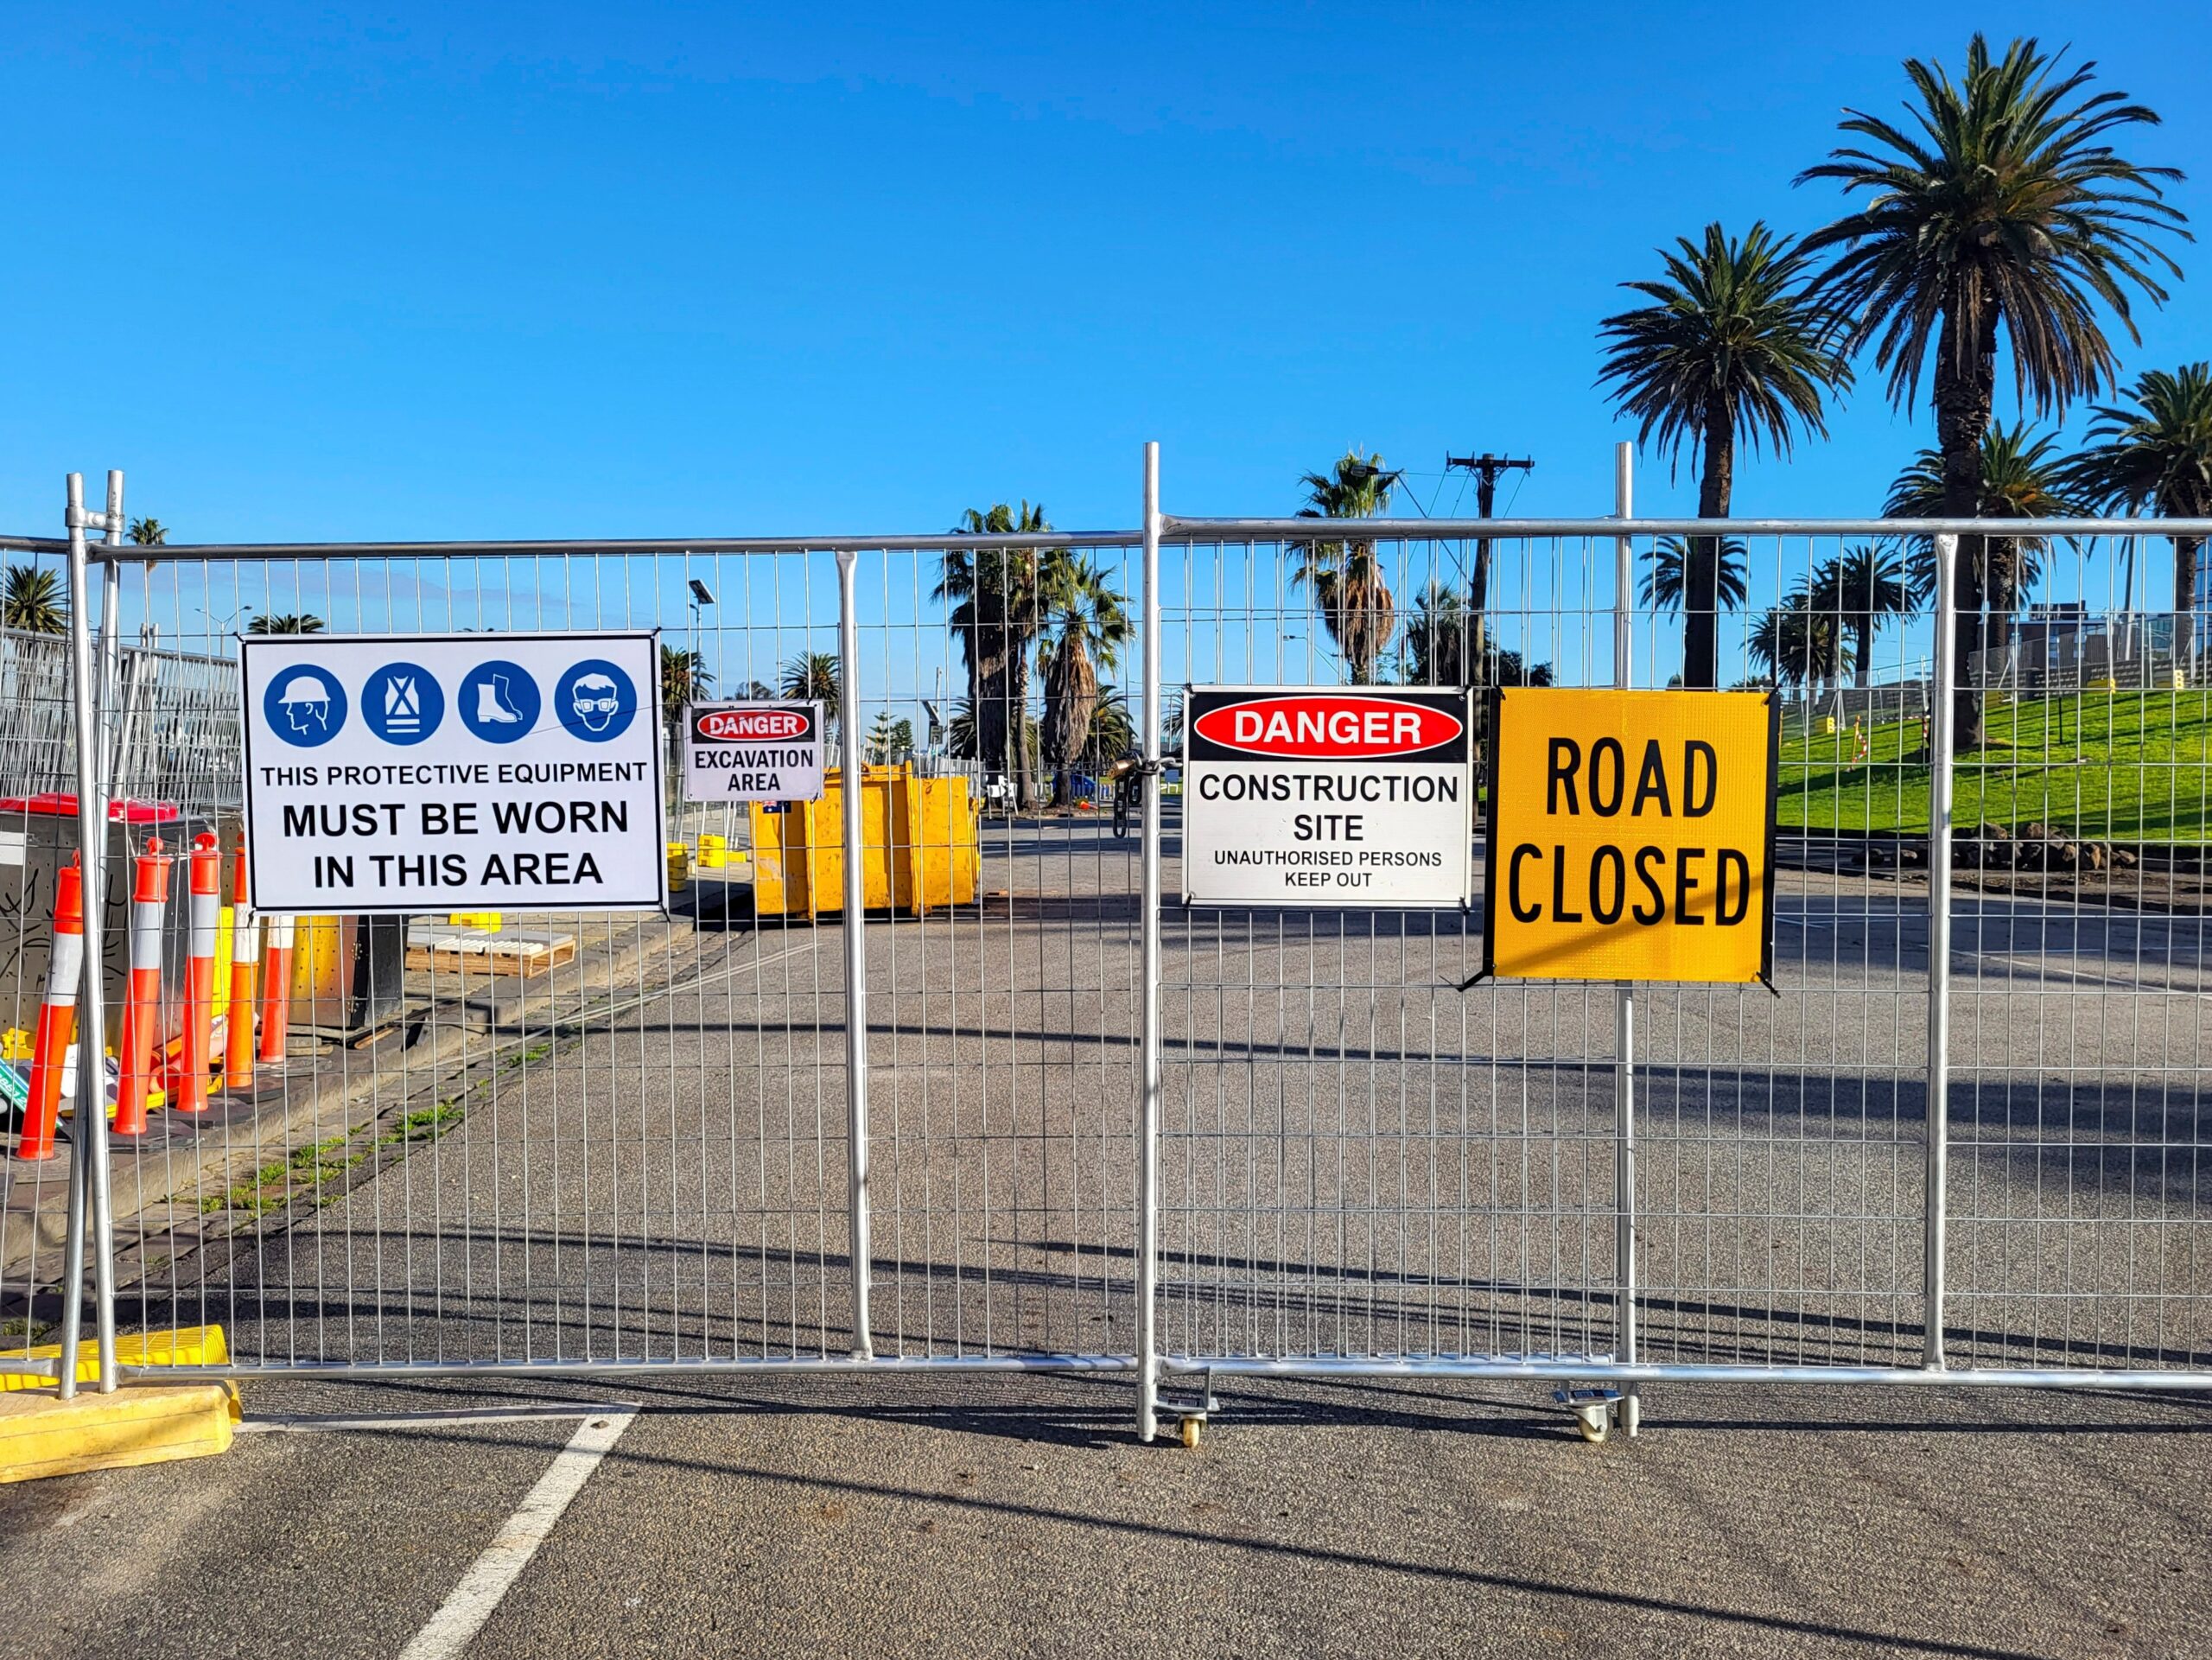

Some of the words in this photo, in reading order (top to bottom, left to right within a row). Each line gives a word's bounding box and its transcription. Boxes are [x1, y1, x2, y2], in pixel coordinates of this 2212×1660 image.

[709, 716, 798, 735] DANGER
[1235, 710, 1421, 744] DANGER
[695, 749, 813, 769] EXCAVATION
[260, 766, 319, 786] THIS
[327, 764, 489, 785] PROTECTIVE
[498, 761, 647, 785] EQUIPMENT
[727, 773, 781, 792] AREA
[1546, 736, 1719, 818] ROAD
[1199, 773, 1458, 803] CONSTRUCTION
[283, 803, 406, 837] MUST
[421, 802, 479, 836] BE
[492, 800, 628, 835] WORN
[1294, 814, 1363, 842] SITE
[315, 855, 354, 888] IN
[368, 854, 467, 887] THIS
[480, 852, 604, 886] AREA
[1214, 850, 1353, 866] UNAUTHORISED
[1359, 851, 1442, 867] PERSONS
[1285, 872, 1332, 887] KEEP
[1337, 872, 1372, 887] OUT
[1508, 843, 1751, 927] CLOSED
